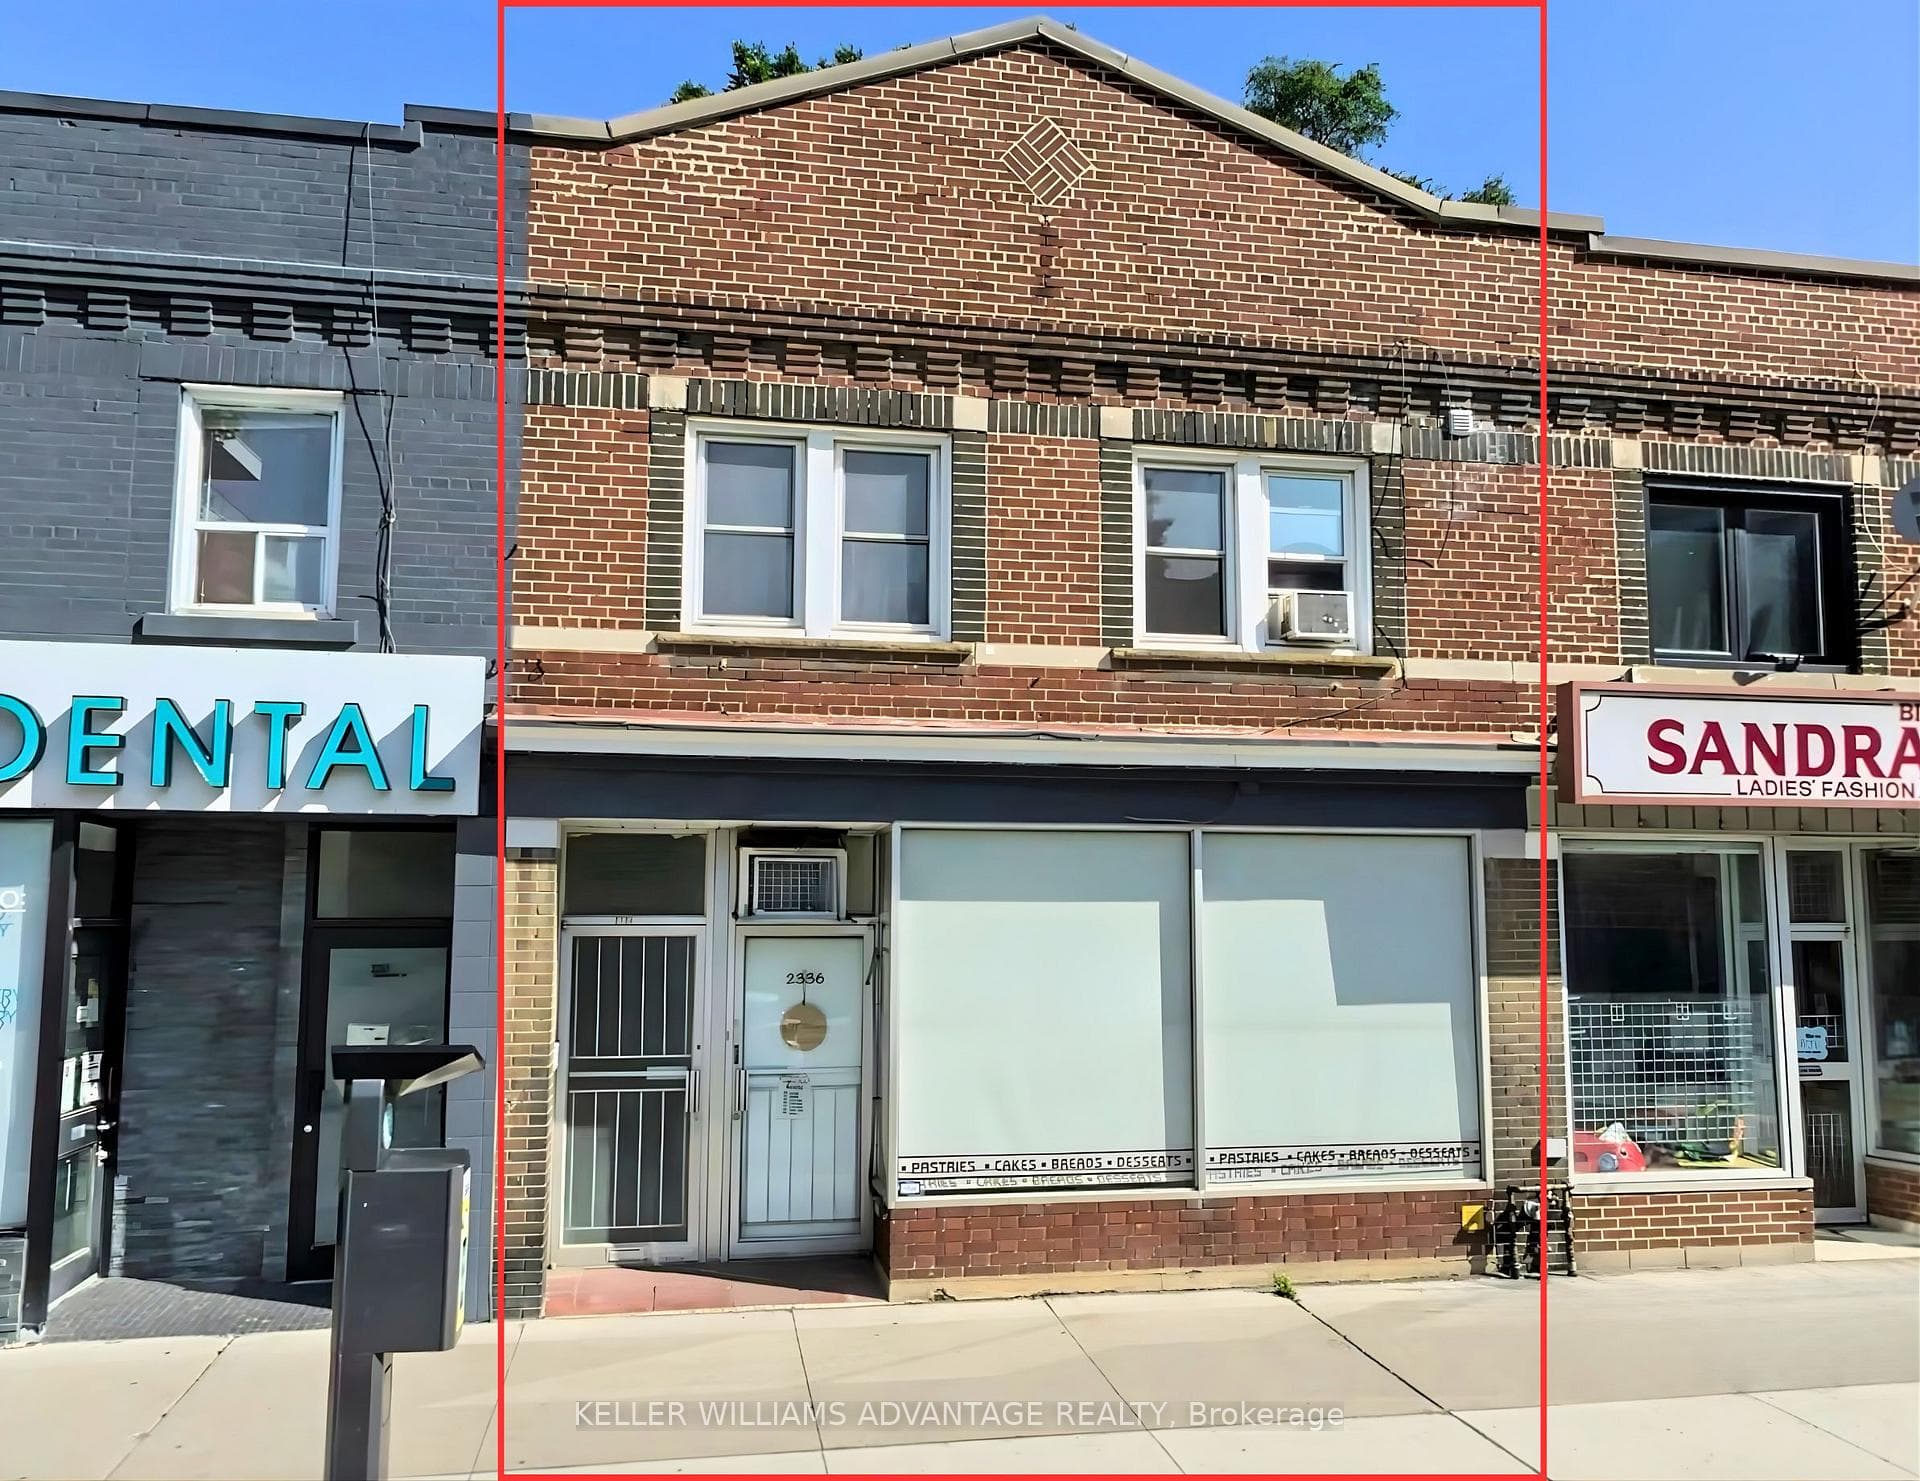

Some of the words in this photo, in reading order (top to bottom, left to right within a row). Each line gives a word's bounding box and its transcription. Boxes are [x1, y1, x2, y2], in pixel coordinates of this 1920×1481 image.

[0, 693, 456, 792] DENTAL
[1647, 718, 1920, 779] SANDRA
[1737, 779, 1815, 797] LADIES'
[1822, 781, 1915, 799] FASHION
[786, 972, 824, 985] 2336
[911, 1161, 976, 1174] PASTRIES
[995, 1160, 1037, 1172] CAKES
[1051, 1157, 1103, 1170] BREADS
[1117, 1156, 1182, 1168] DESSERTS
[1219, 1151, 1280, 1164] PASTRIES
[1297, 1150, 1336, 1163] CAKES
[1349, 1149, 1397, 1161] BREADS
[1410, 1147, 1471, 1159] DESSERTS
